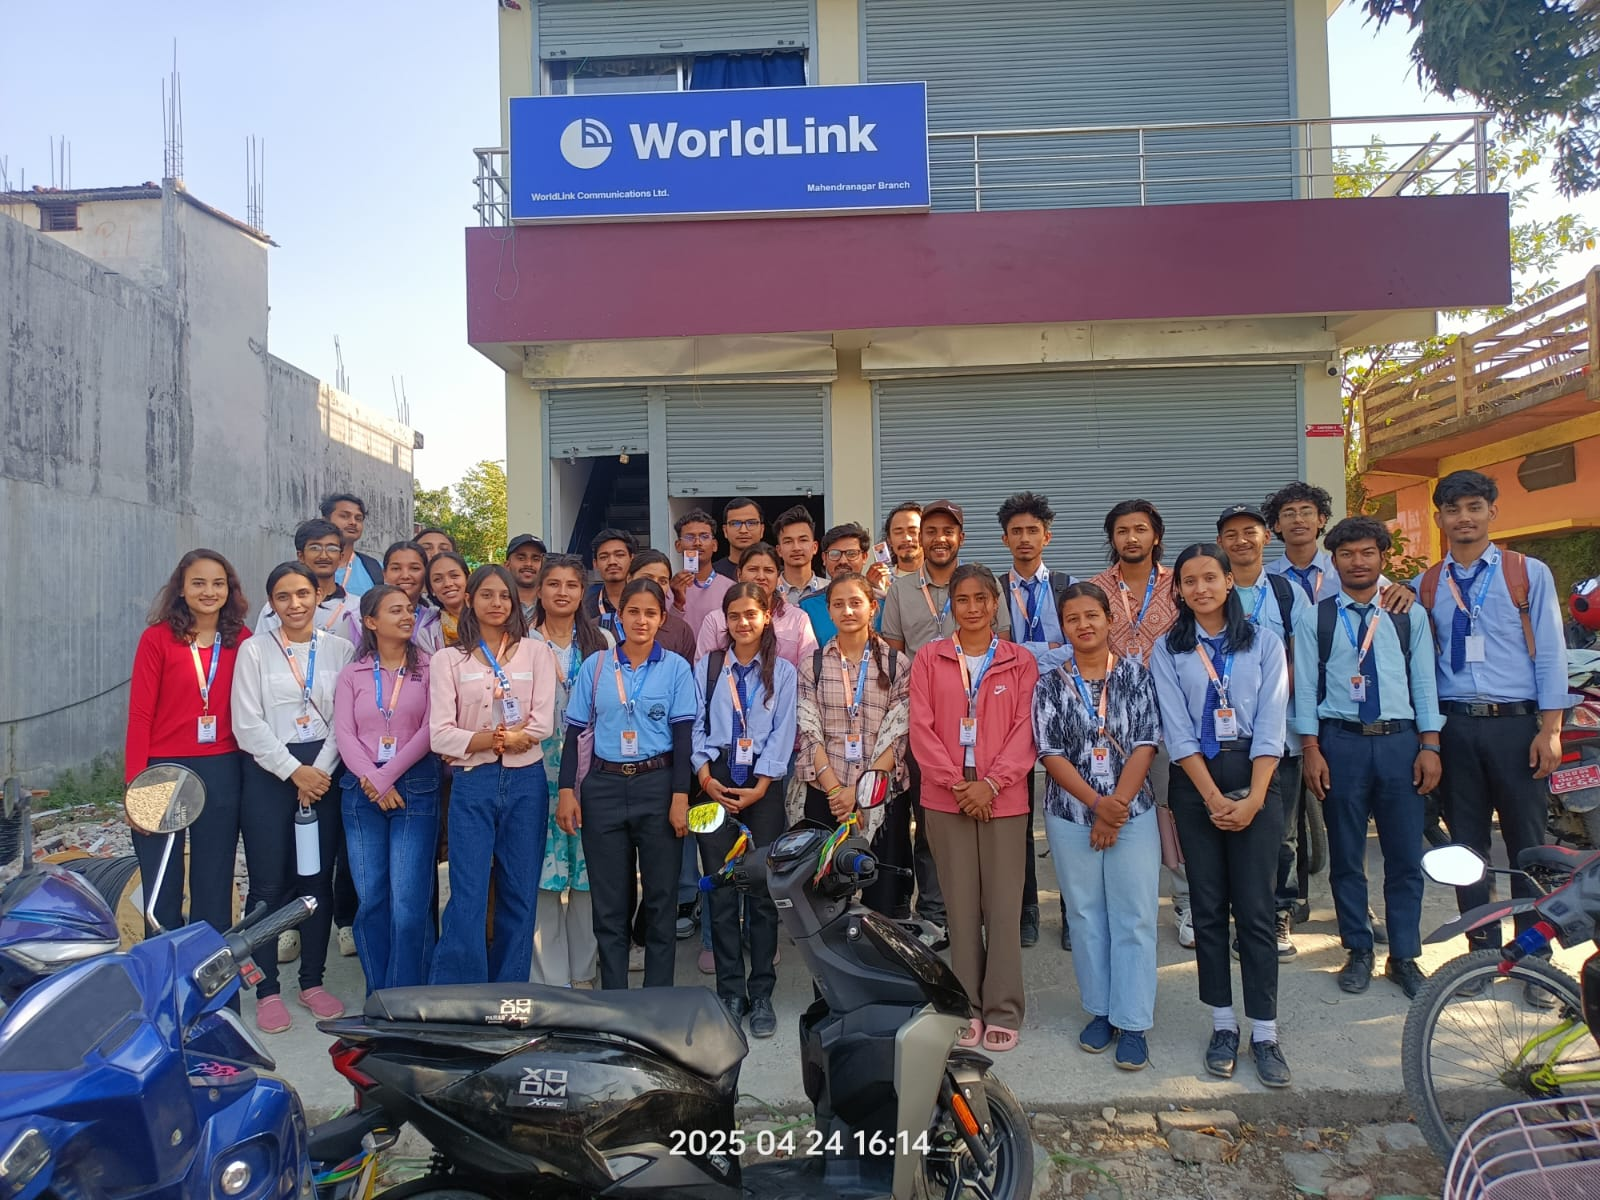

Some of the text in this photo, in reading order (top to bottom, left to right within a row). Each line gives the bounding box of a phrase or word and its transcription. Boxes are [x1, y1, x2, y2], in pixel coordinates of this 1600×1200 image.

[630, 115, 877, 160] WorldLink
[807, 181, 910, 193] Mahendranagar Branch
[531, 189, 669, 201] WorldLink Communications Ltd.
